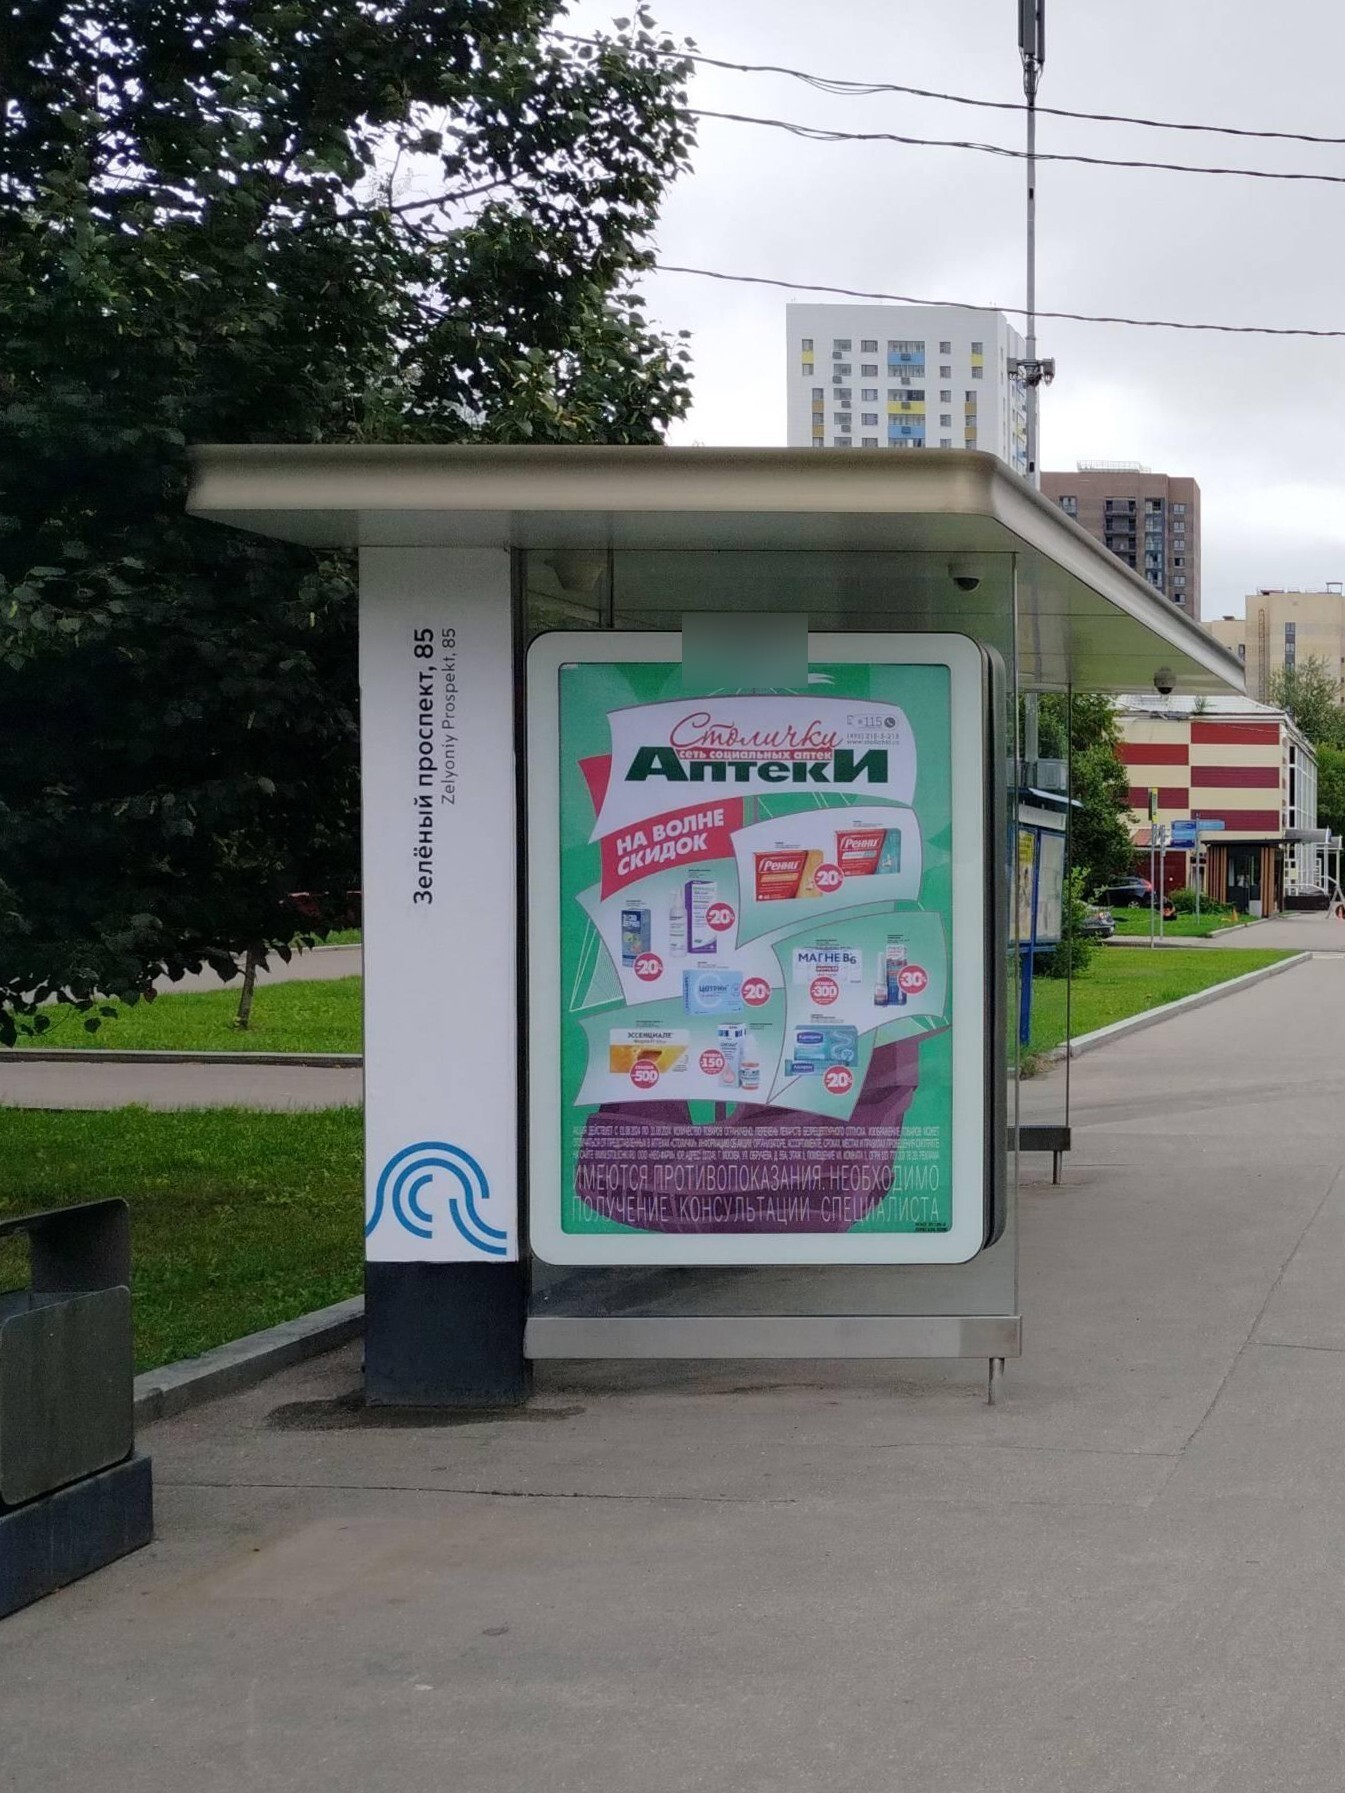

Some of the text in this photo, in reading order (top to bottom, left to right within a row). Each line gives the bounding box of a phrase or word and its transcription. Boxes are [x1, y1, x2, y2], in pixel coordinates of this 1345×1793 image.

[441, 628, 458, 805] Zelyoniy Prospekt, 85
[669, 711, 843, 749] Столички
[413, 628, 438, 904] Зелёный проспект, 85
[679, 750, 833, 760] сеть социальных аптек
[616, 808, 724, 856] НА ВОЛНЕ
[617, 832, 708, 876] СКИДОК
[798, 952, 841, 963] МАГНЕ
[573, 1164, 940, 1194] ИМЕЮТСЯ ПРОТИВОПОКАЗАНИЯ. НЕОБХОДИМО
[572, 1195, 939, 1225] ПОЛУЧЕНИЕ КОНСУЛЬТАЦИИ СПЕЦИАЛИСТА
